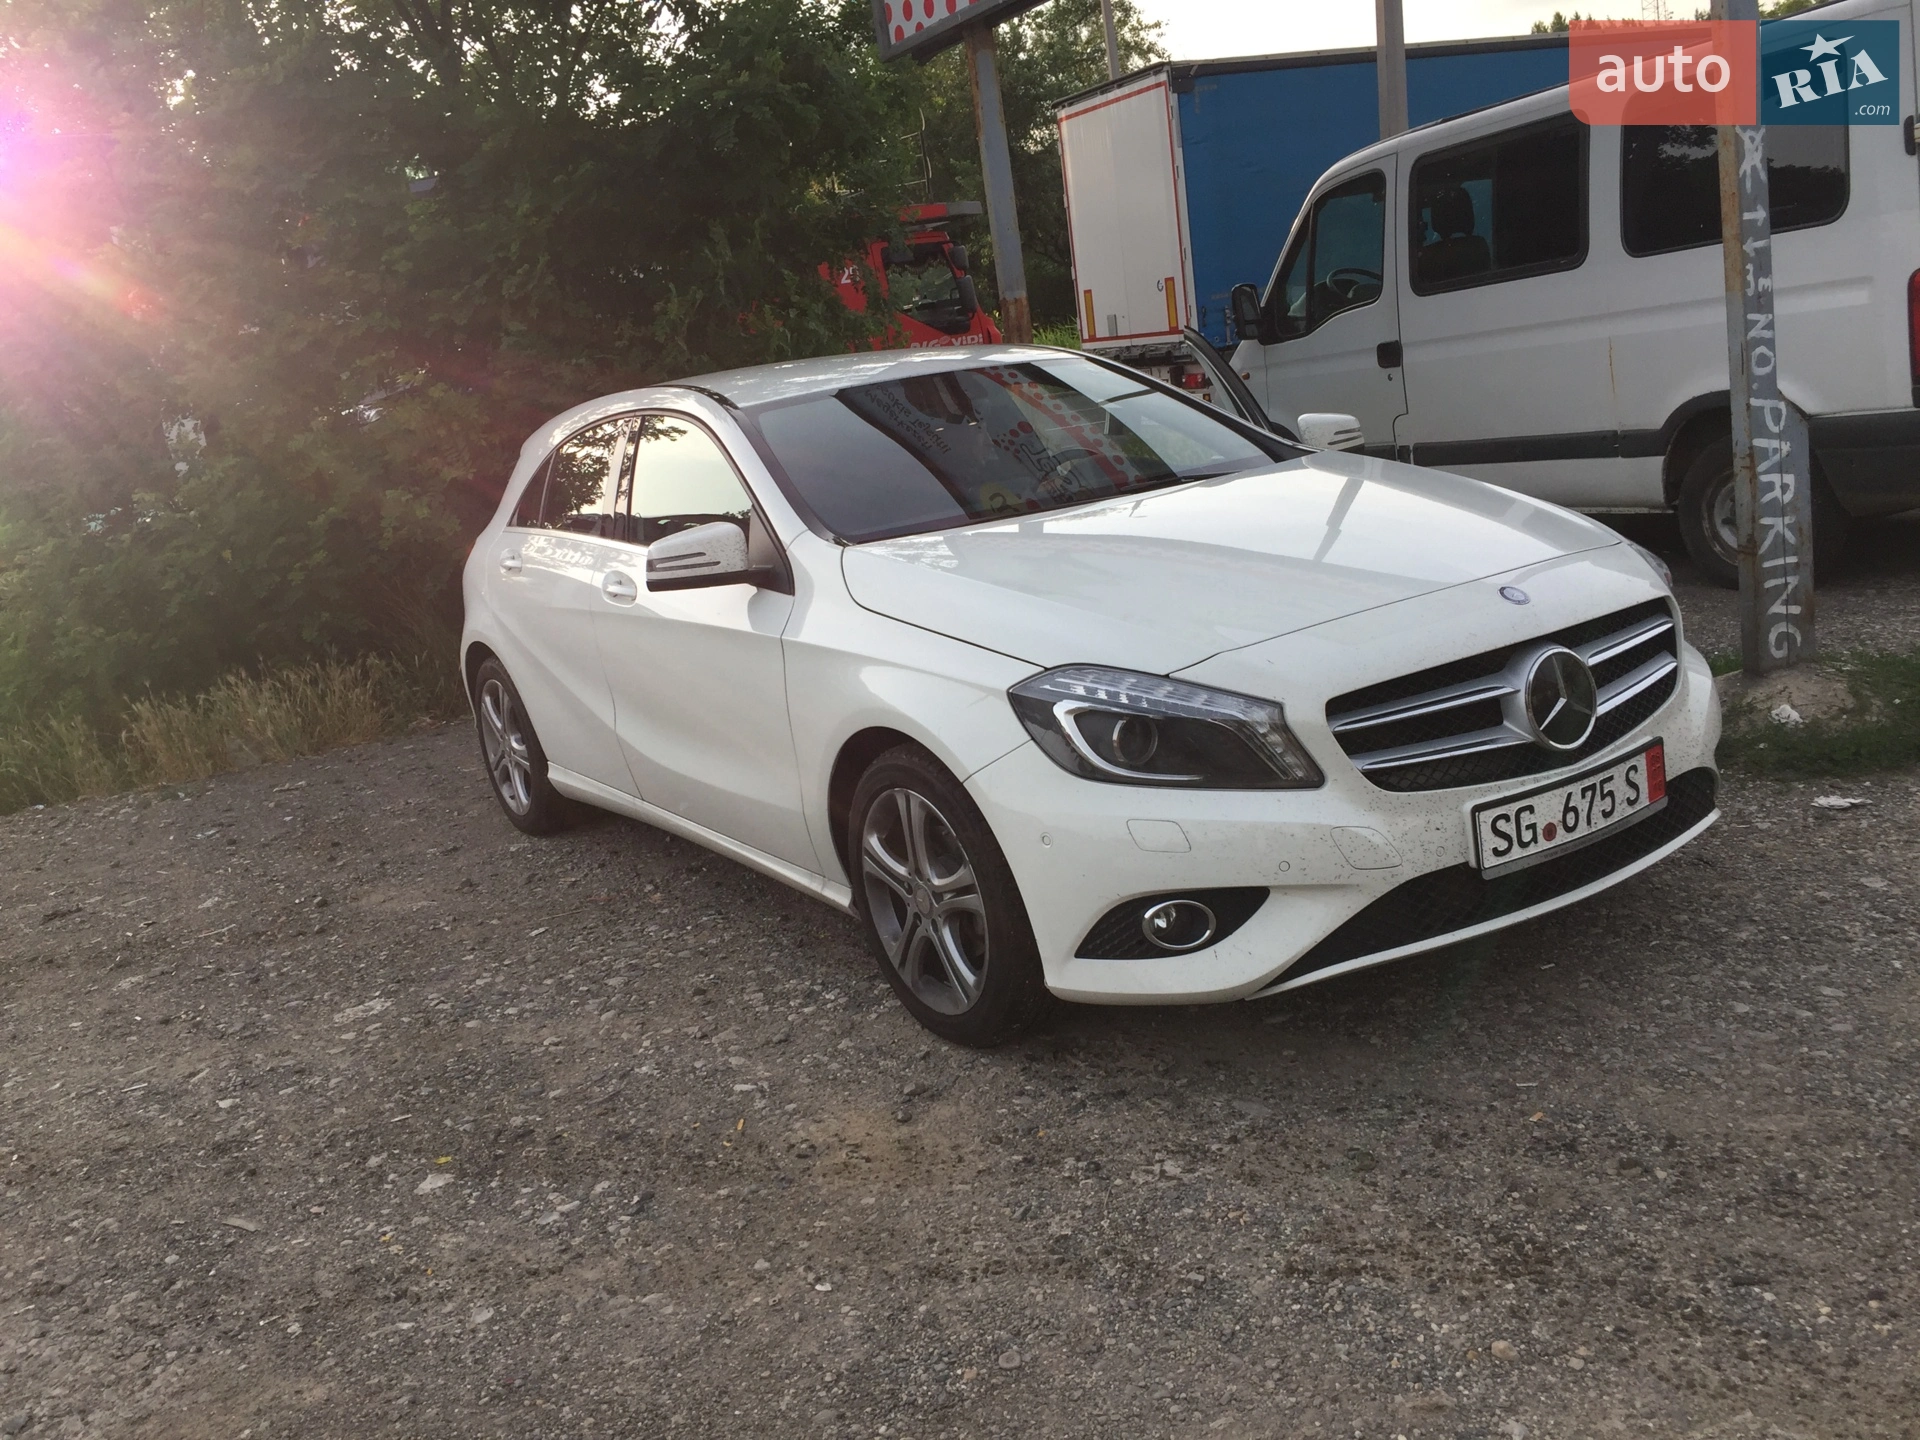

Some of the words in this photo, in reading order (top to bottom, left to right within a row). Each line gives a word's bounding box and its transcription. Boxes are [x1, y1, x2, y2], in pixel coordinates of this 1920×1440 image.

[1490, 804, 1539, 858] SG
[1561, 774, 1616, 834] 675
[1624, 763, 1641, 807] S
